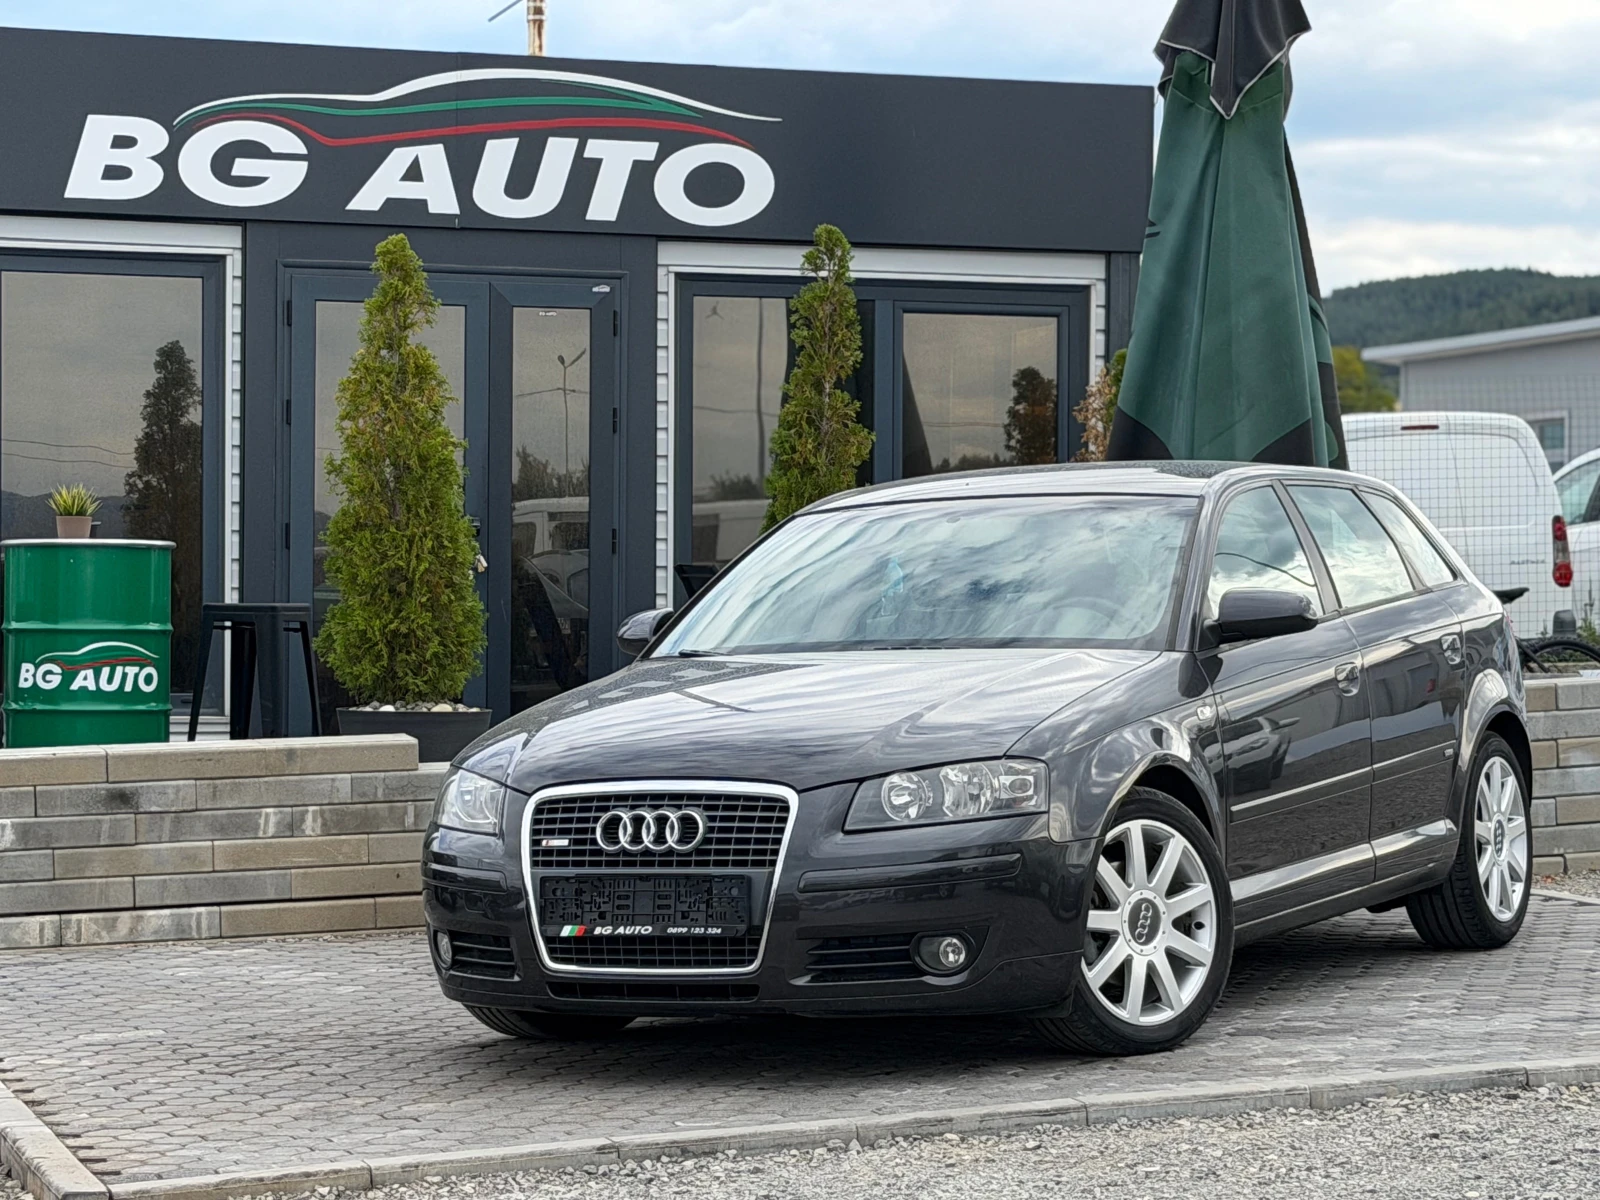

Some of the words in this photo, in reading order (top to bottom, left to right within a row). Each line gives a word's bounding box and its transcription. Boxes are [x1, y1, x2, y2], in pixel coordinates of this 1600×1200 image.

[64, 114, 308, 207] BG
[345, 137, 775, 226] AUTO
[18, 662, 62, 690] BG
[69, 666, 158, 693] AUTO
[593, 926, 613, 935] BG
[614, 925, 652, 935] AUTO
